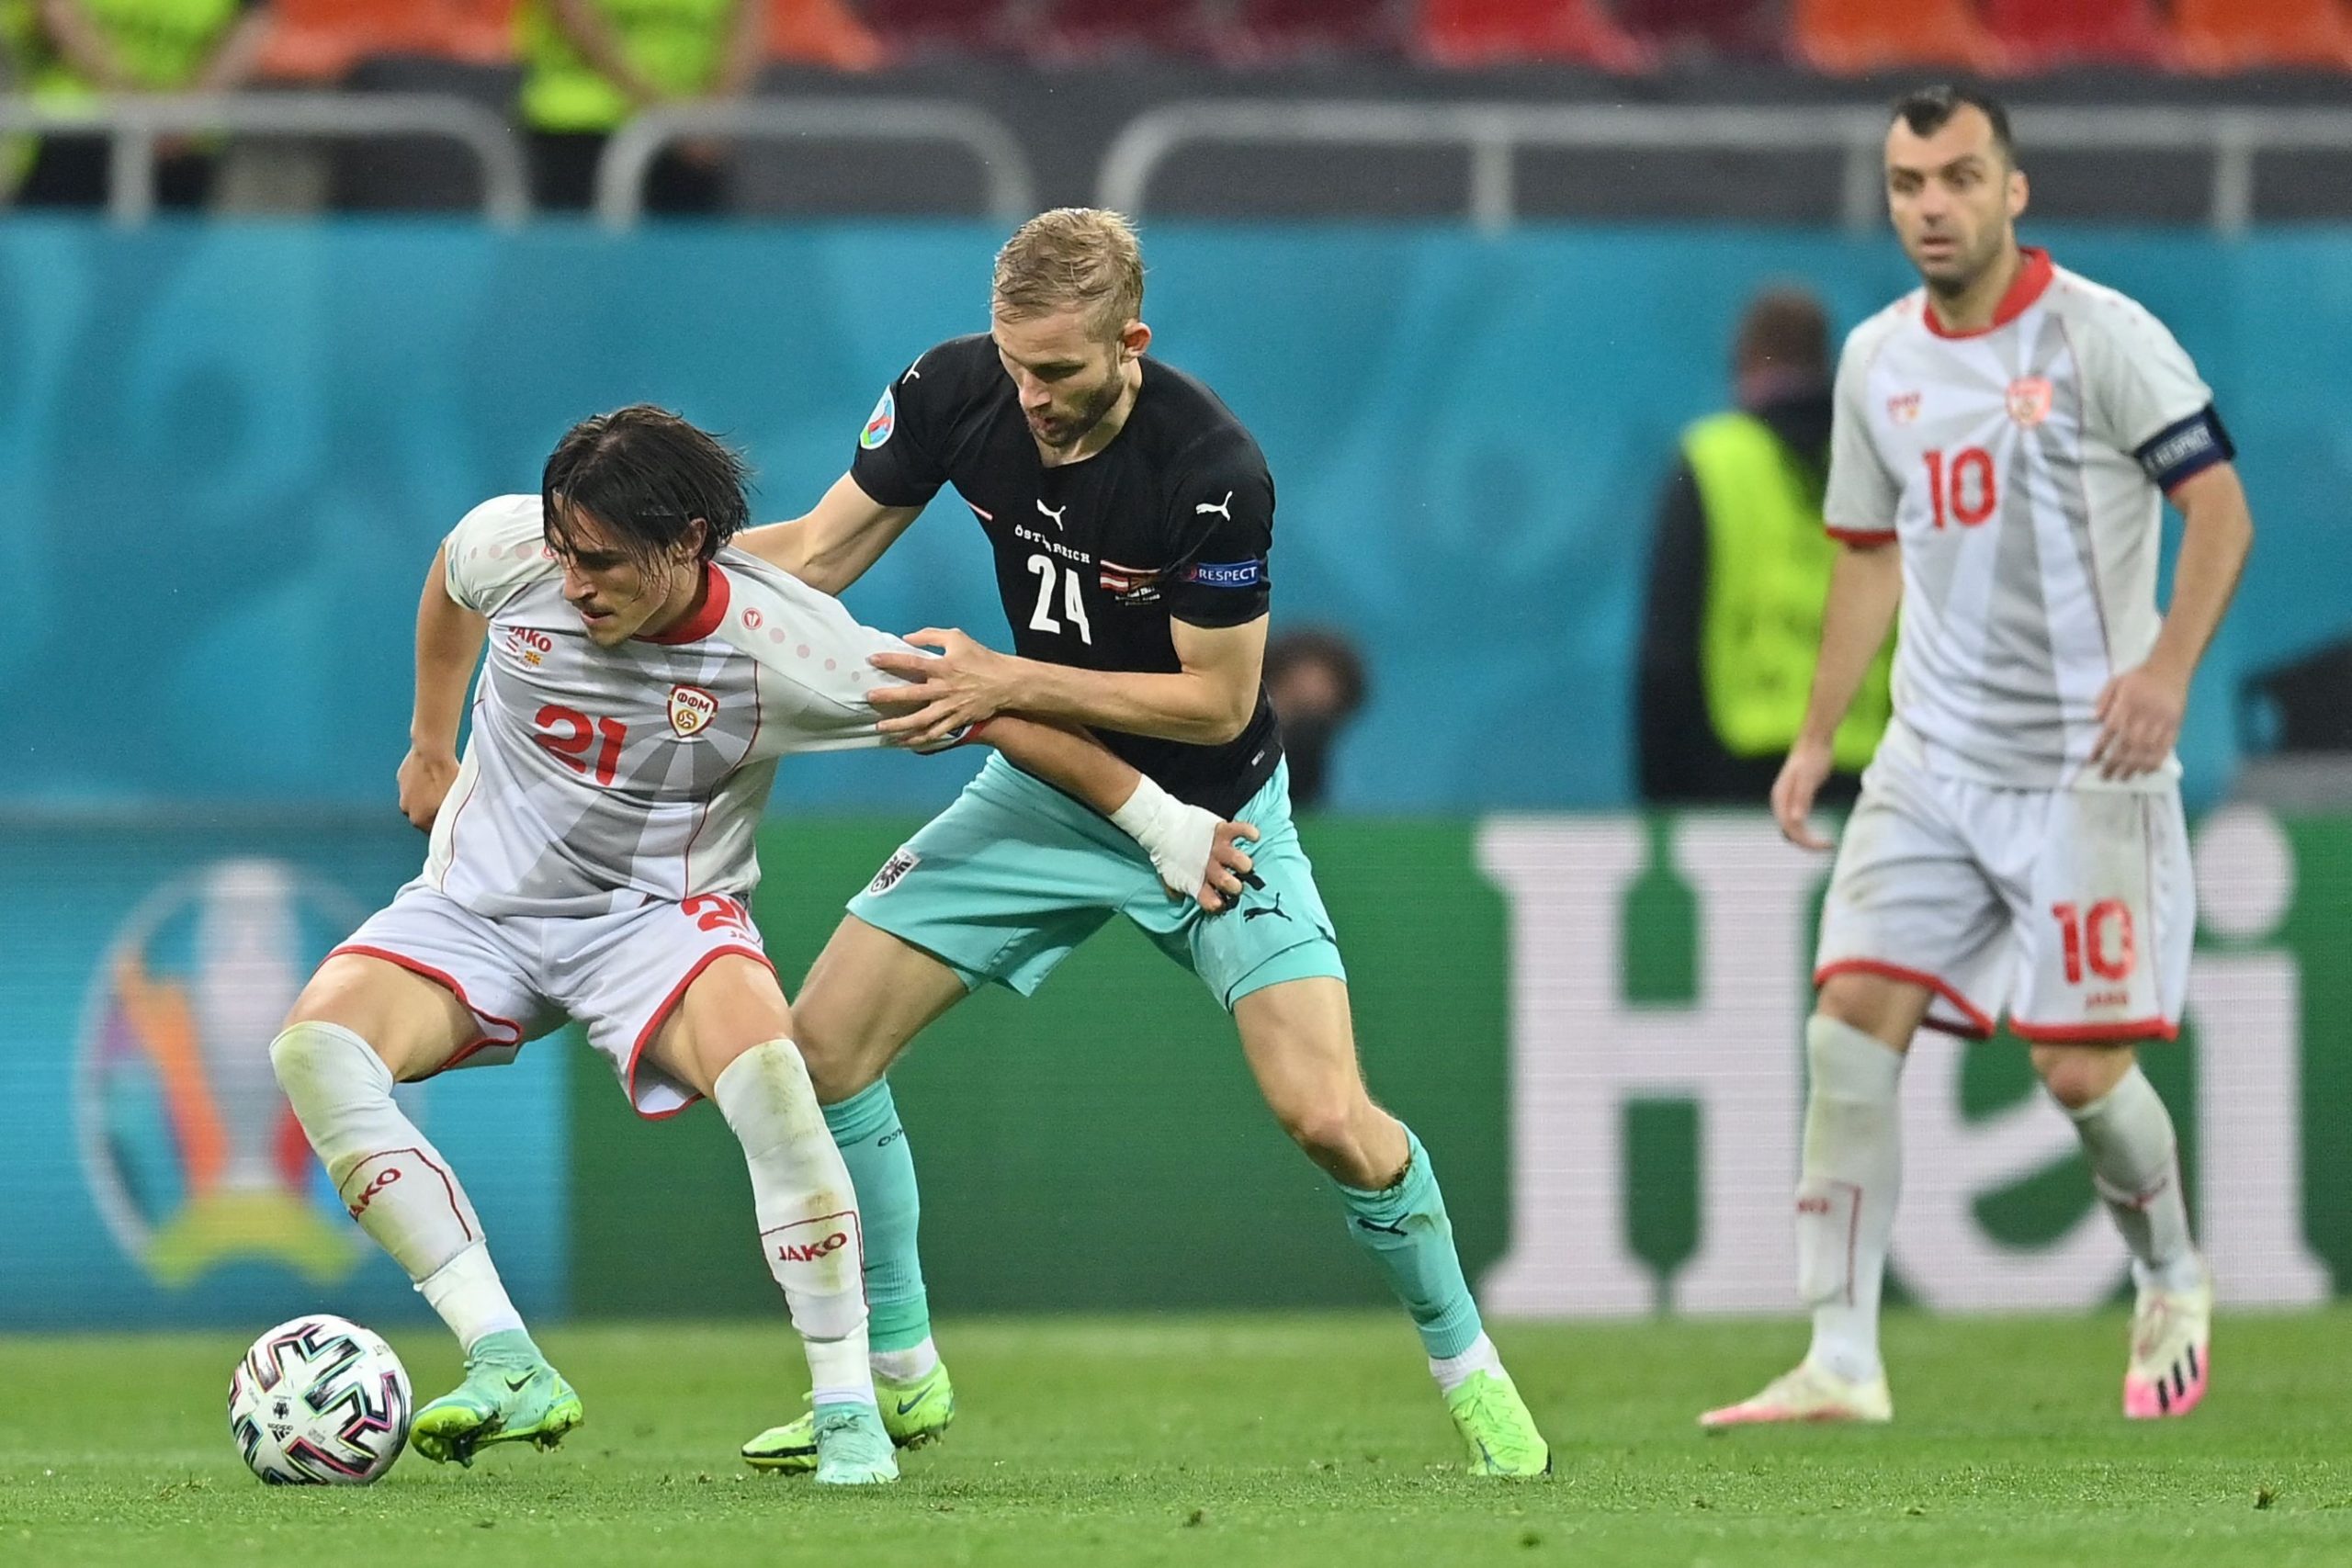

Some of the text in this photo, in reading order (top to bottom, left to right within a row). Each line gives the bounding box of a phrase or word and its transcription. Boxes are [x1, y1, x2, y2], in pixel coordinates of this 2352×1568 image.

[1921, 446, 1996, 530] 10
[1027, 554, 1091, 646] 24
[1198, 566, 1258, 581] RESPECT
[534, 705, 628, 786] 21
[2052, 899, 2136, 986] 10
[348, 1168, 401, 1223] AKO
[778, 1233, 848, 1262] JAKO
